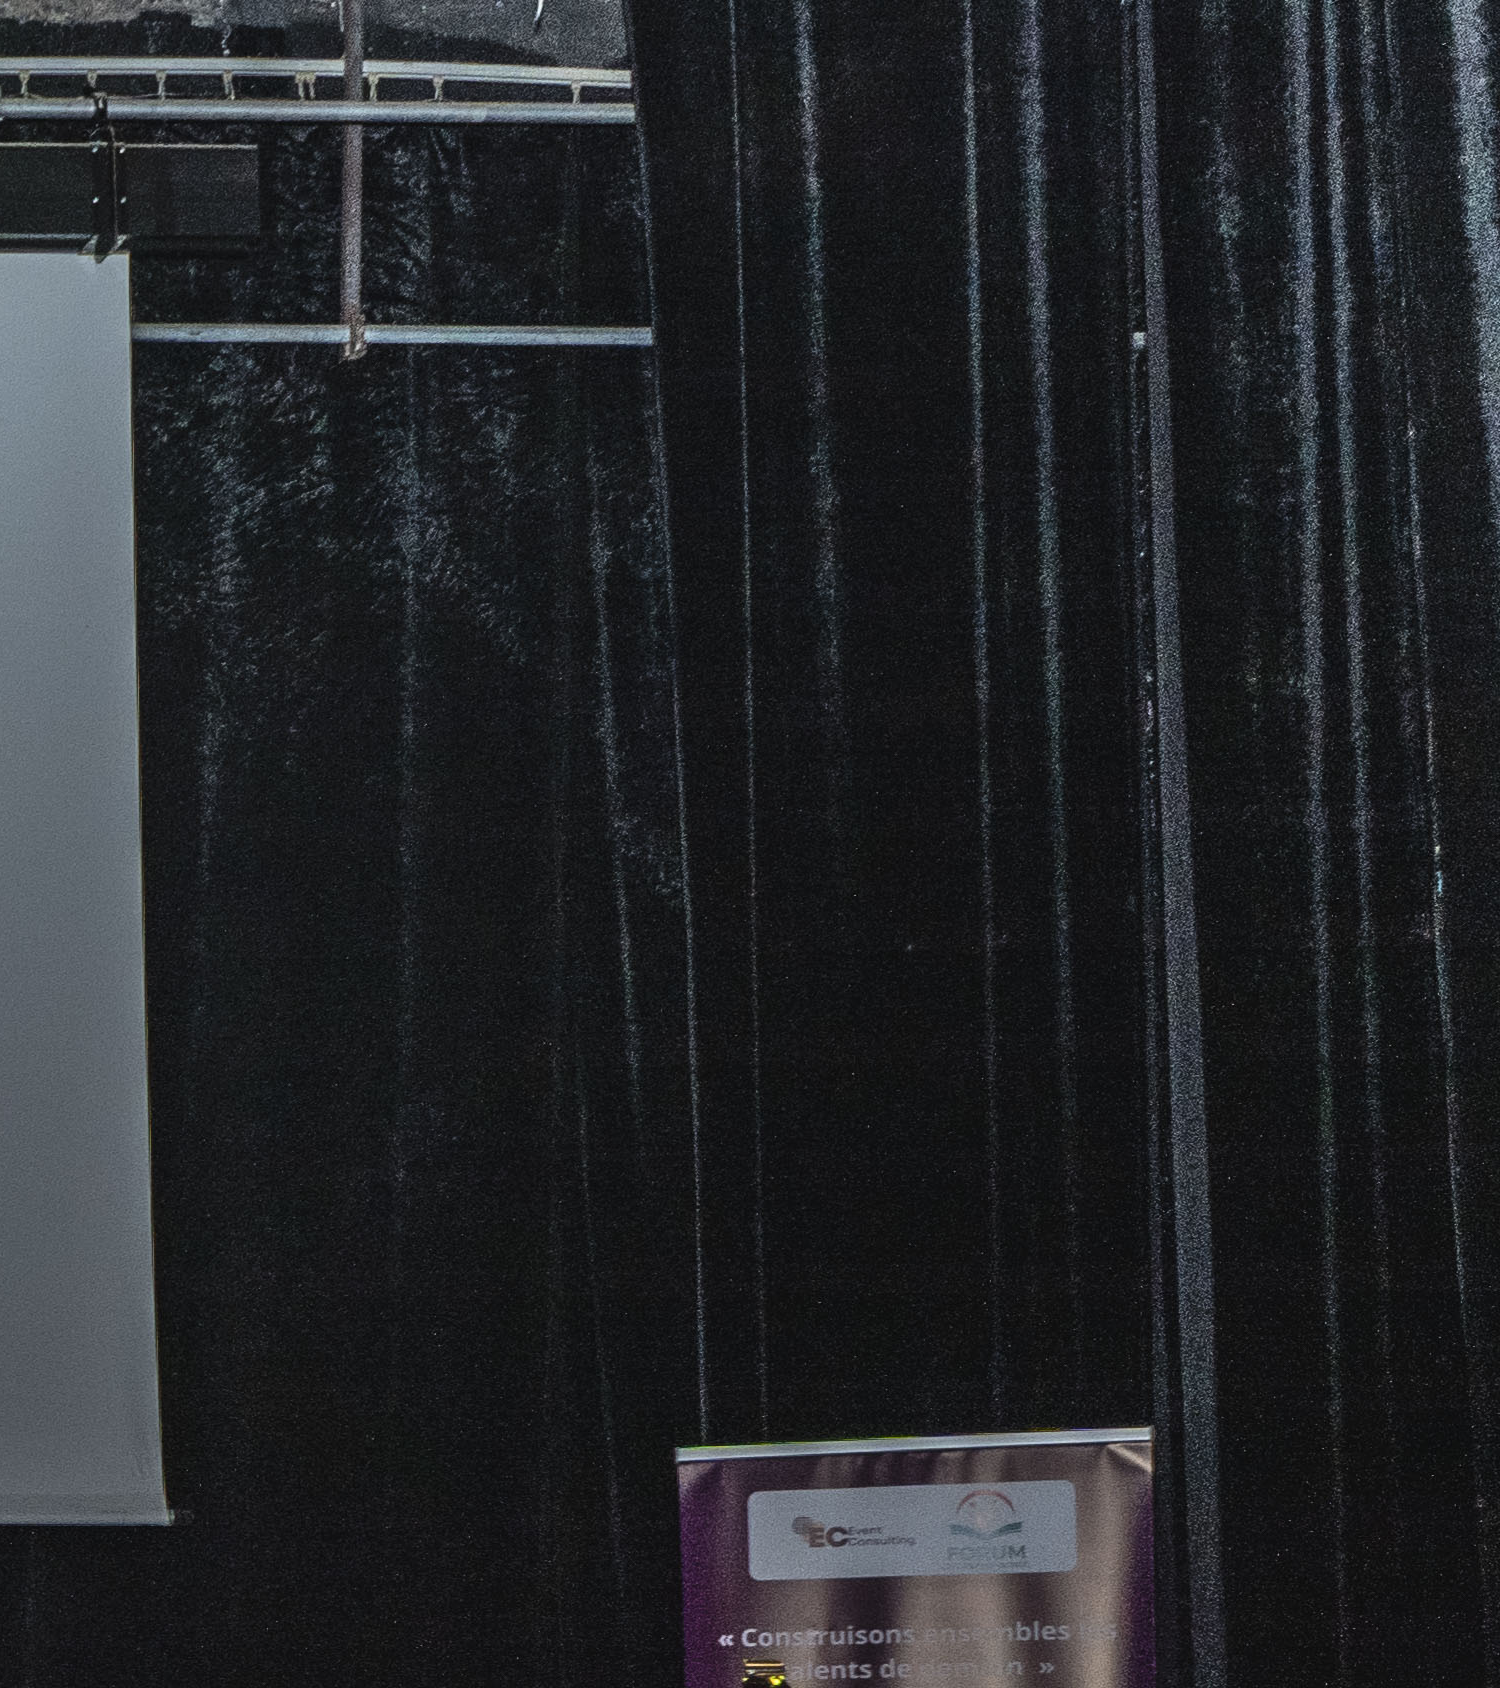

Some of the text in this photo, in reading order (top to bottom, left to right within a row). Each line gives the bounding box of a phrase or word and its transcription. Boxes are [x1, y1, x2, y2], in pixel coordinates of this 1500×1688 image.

[809, 1525, 849, 1549] EC
[848, 1535, 917, 1548] Consulting
[849, 1525, 883, 1536] Event
[741, 1624, 914, 1649] Construisons
[790, 1659, 873, 1682] alents
